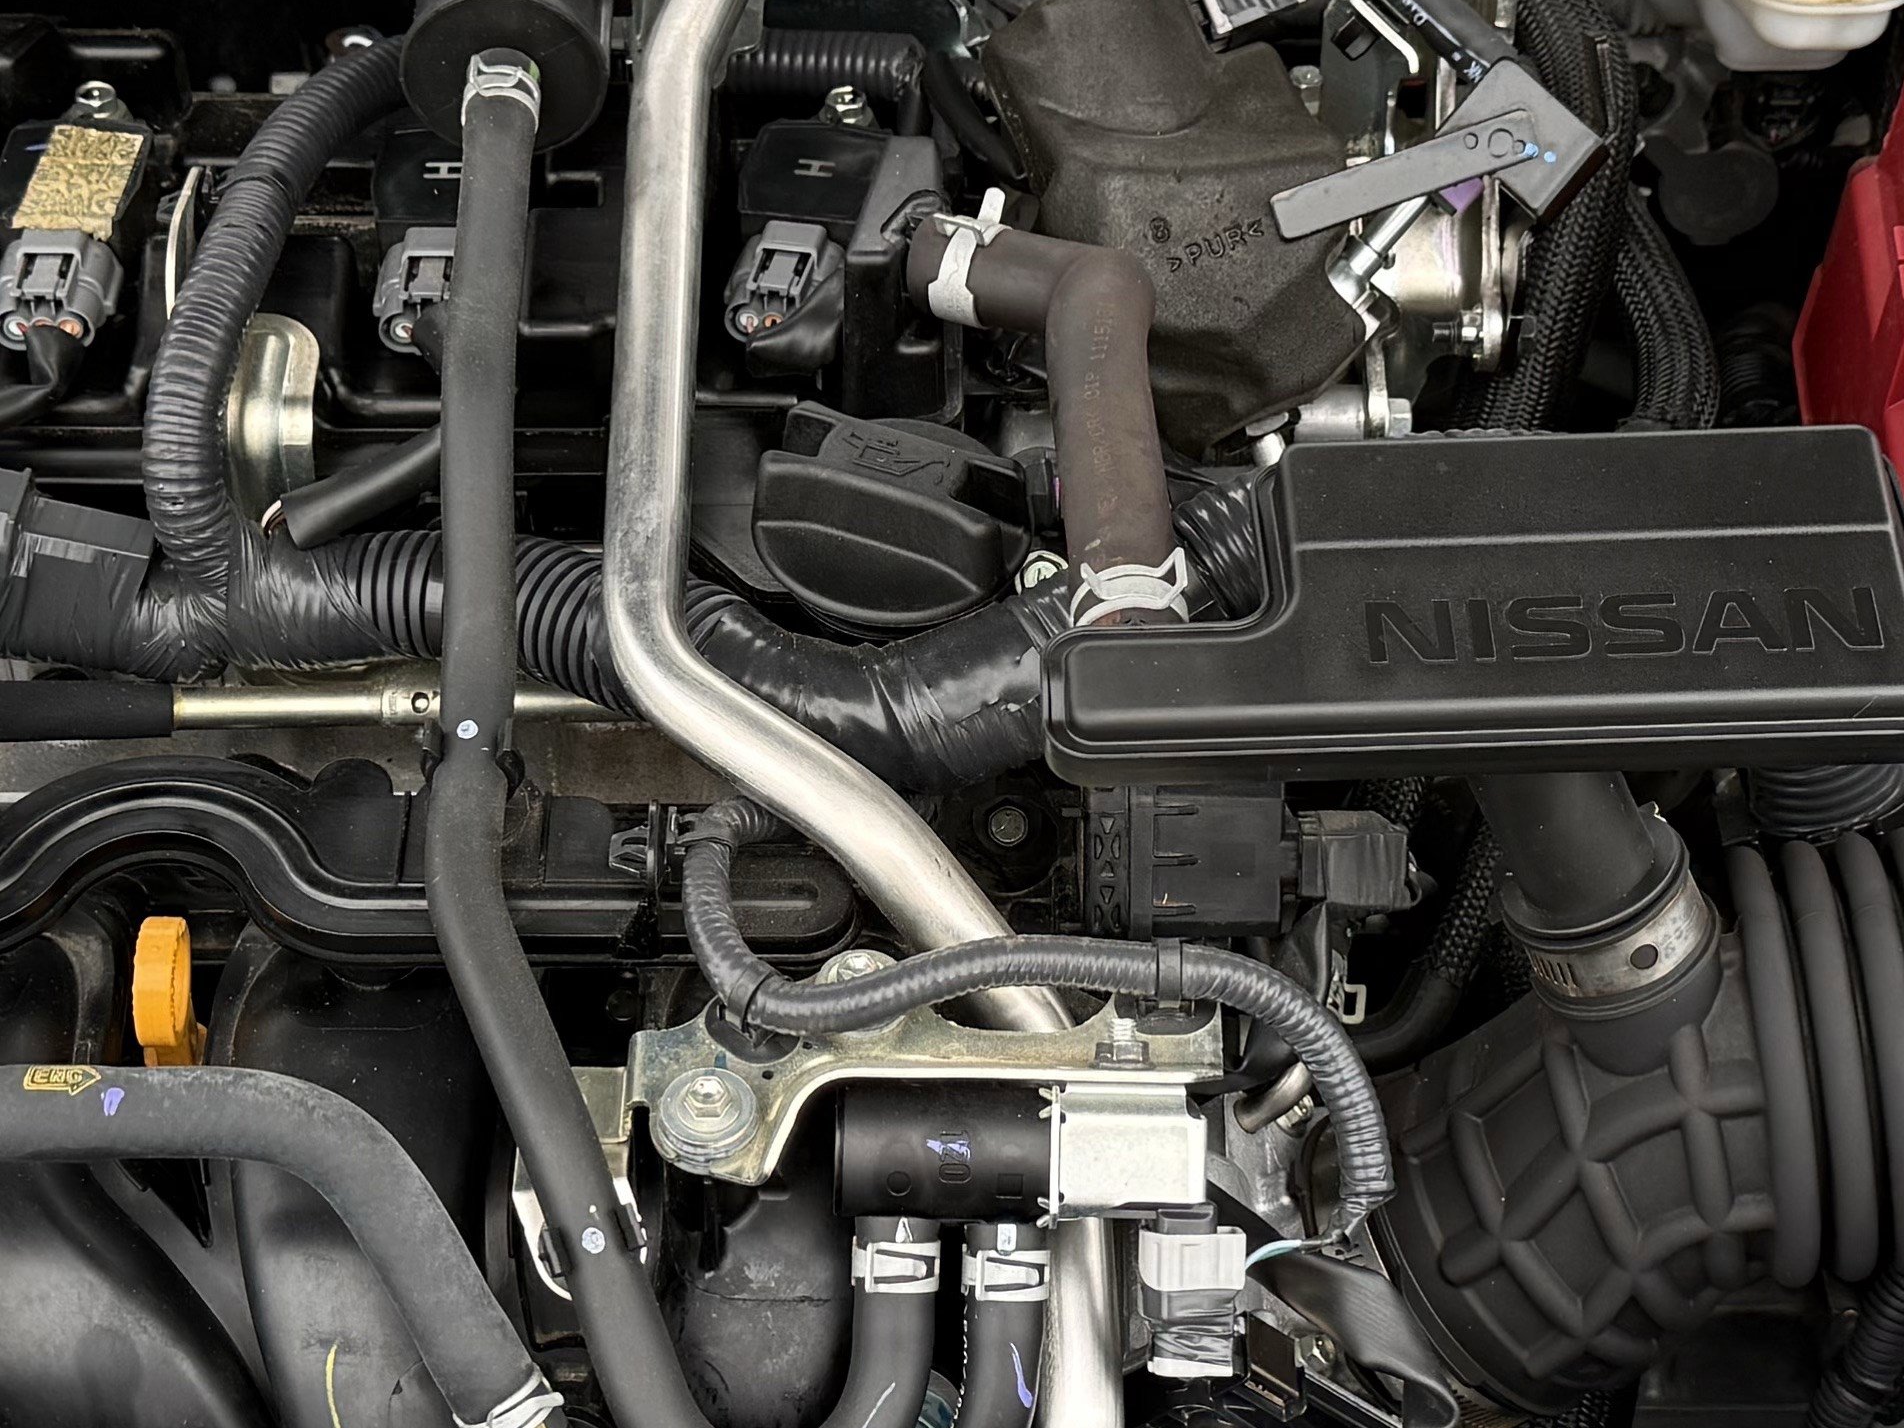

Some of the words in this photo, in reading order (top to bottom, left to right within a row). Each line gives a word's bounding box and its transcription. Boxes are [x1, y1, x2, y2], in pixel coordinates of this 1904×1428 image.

[1166, 218, 1265, 273] >PUR<
[1363, 587, 1885, 664] NISSAN
[32, 1068, 84, 1085] ENG
